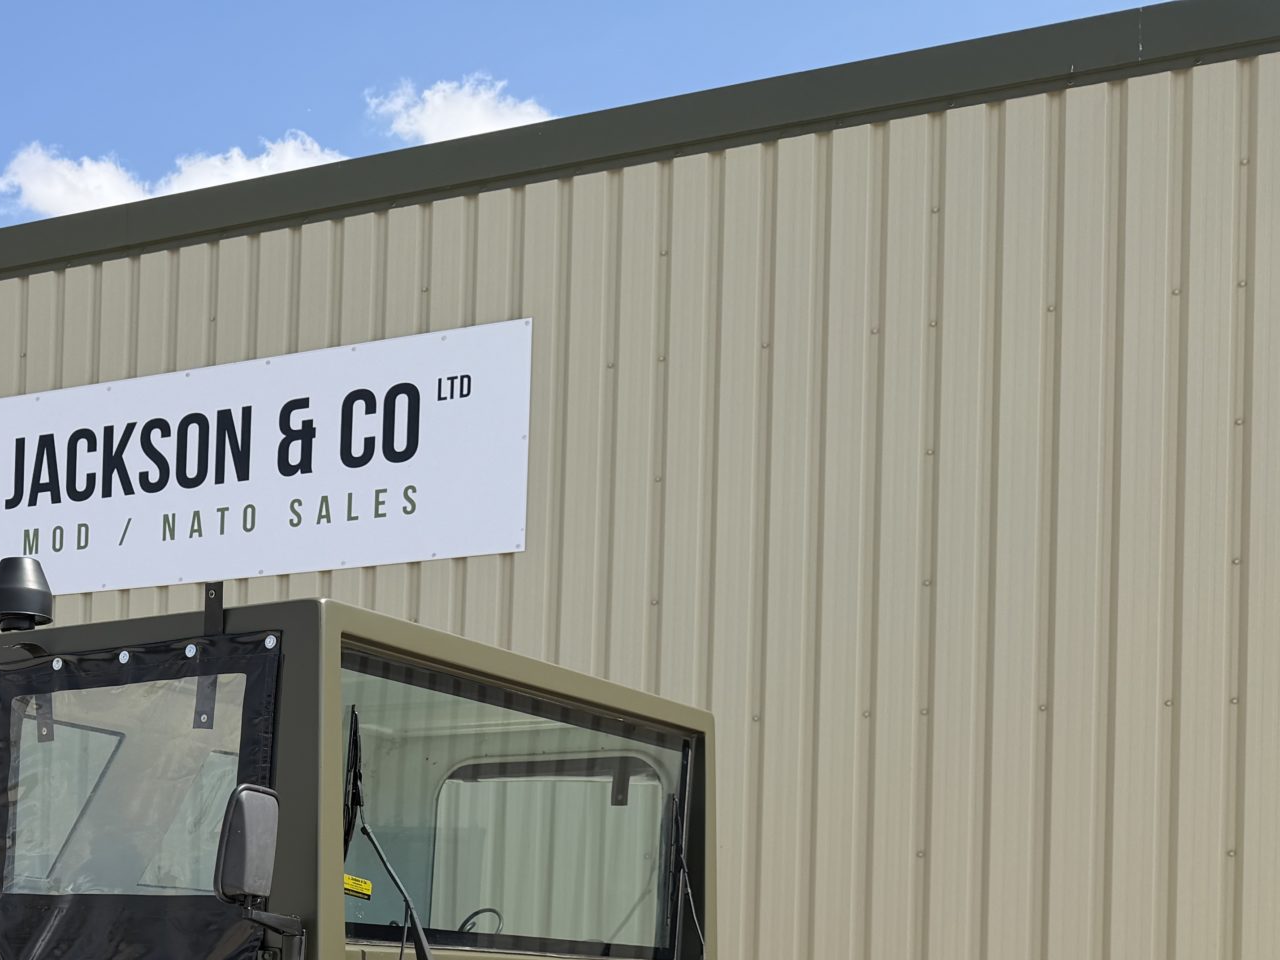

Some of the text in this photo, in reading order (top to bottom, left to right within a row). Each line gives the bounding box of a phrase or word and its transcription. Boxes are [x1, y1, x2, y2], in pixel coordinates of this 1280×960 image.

[4, 405, 253, 511] JACKSON
[276, 396, 317, 478] &
[339, 382, 421, 469] CO
[436, 374, 472, 402] LTD
[22, 522, 90, 556] MOD
[118, 517, 133, 547] /
[161, 503, 257, 542] NATO
[288, 484, 418, 528] SALES
